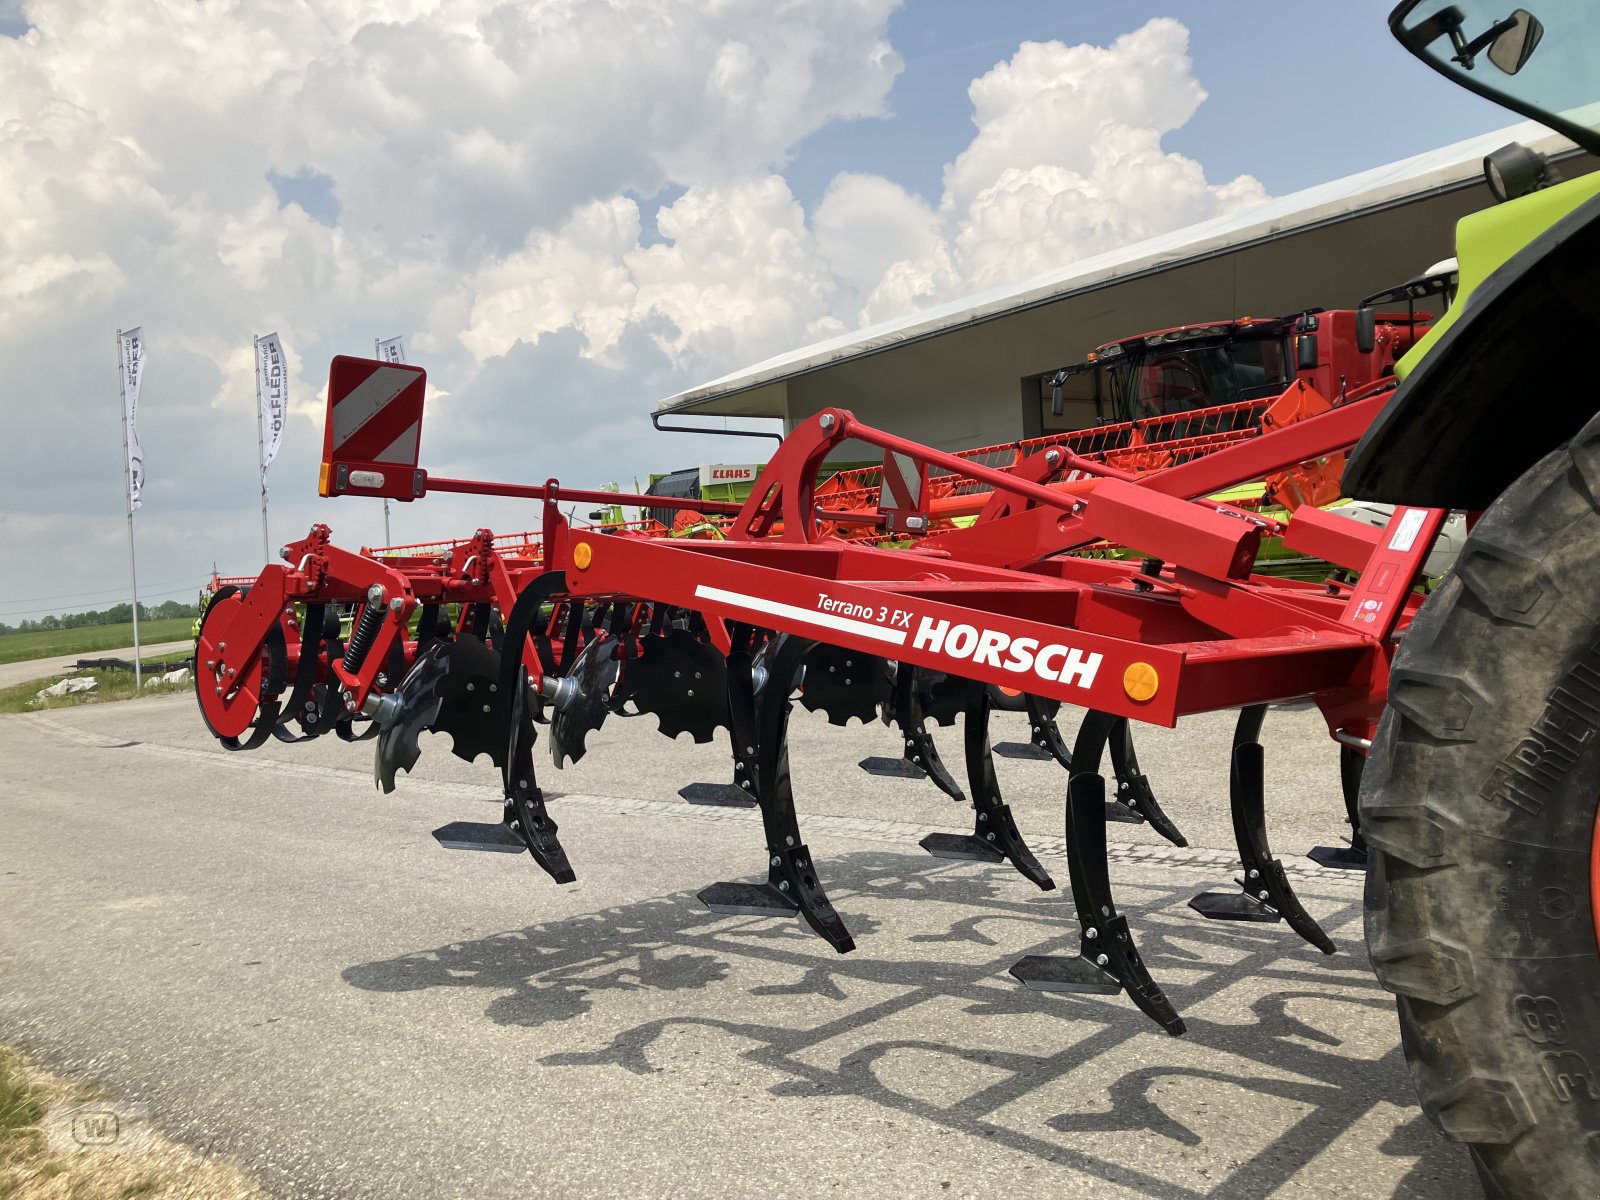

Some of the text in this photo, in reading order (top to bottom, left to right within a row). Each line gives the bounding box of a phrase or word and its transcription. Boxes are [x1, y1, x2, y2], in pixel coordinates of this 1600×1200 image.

[712, 469, 751, 479] CLAAS
[817, 593, 914, 629] Terrano 3 FX
[912, 615, 1104, 690] HORSCH
